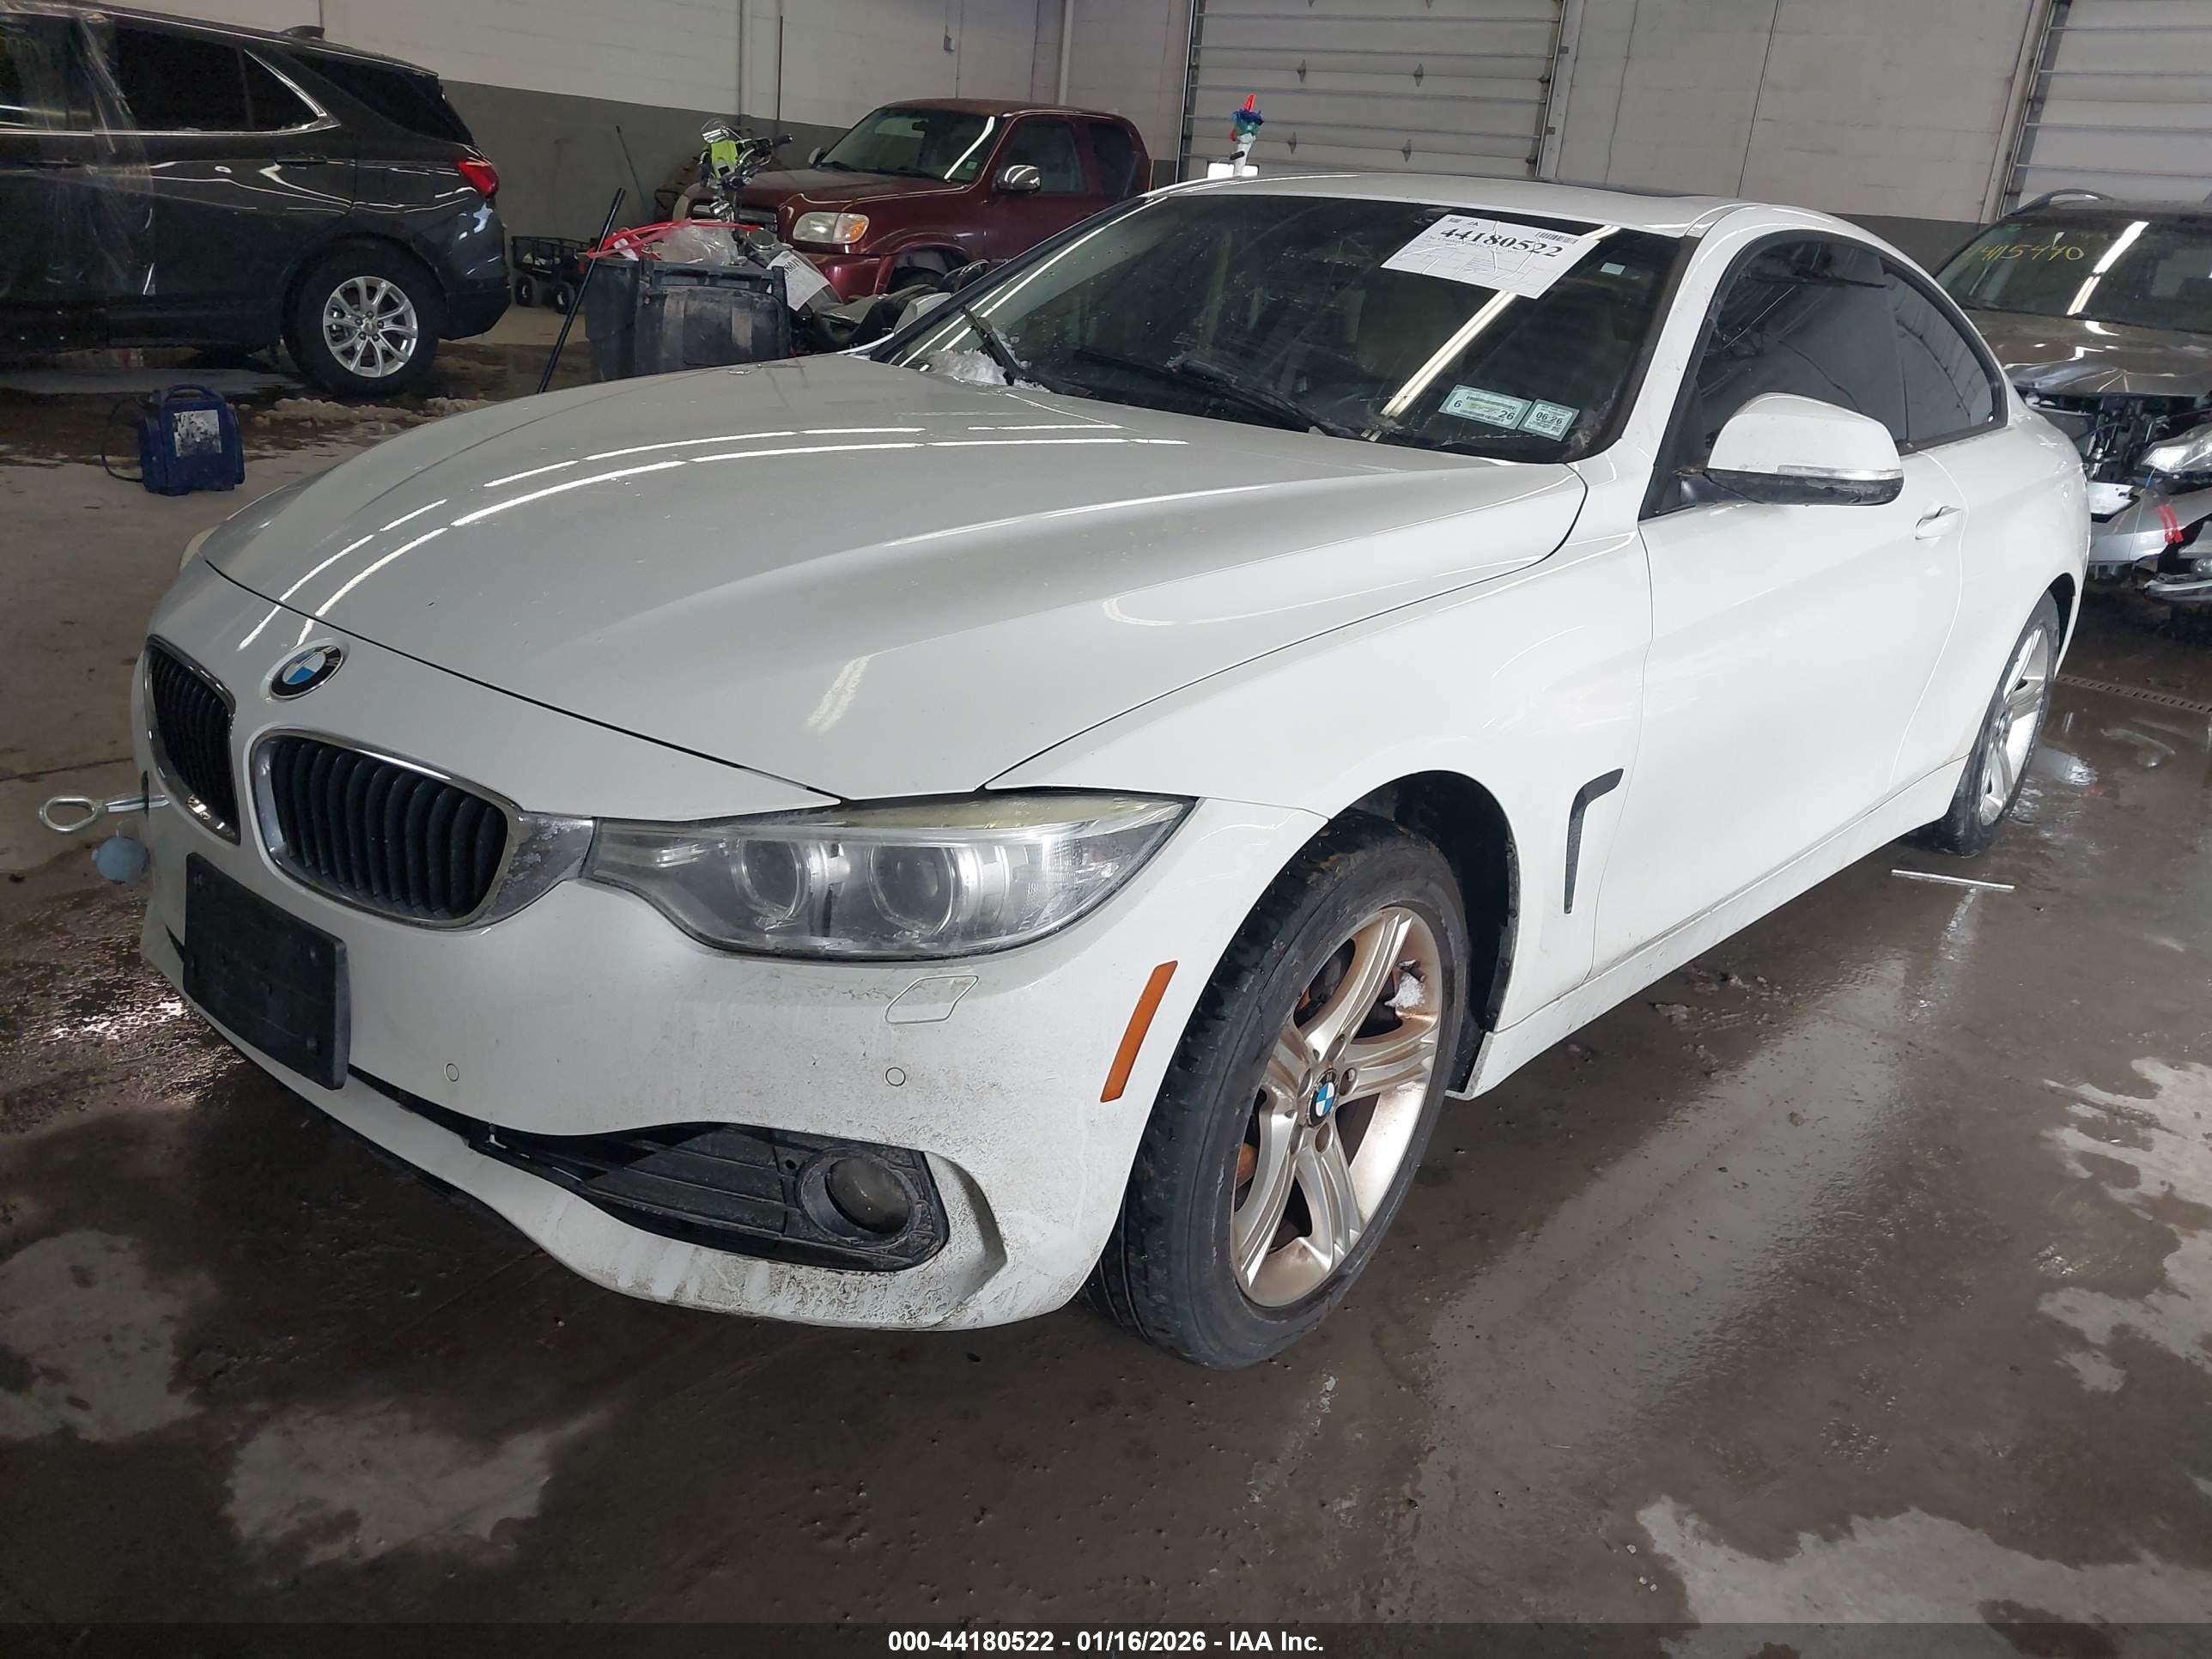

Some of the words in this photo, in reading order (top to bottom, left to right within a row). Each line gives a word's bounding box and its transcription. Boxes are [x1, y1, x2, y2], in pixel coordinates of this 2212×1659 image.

[1440, 228, 1565, 258] 44180522
[1453, 399, 1463, 409] 6
[1498, 410, 1516, 421] 26
